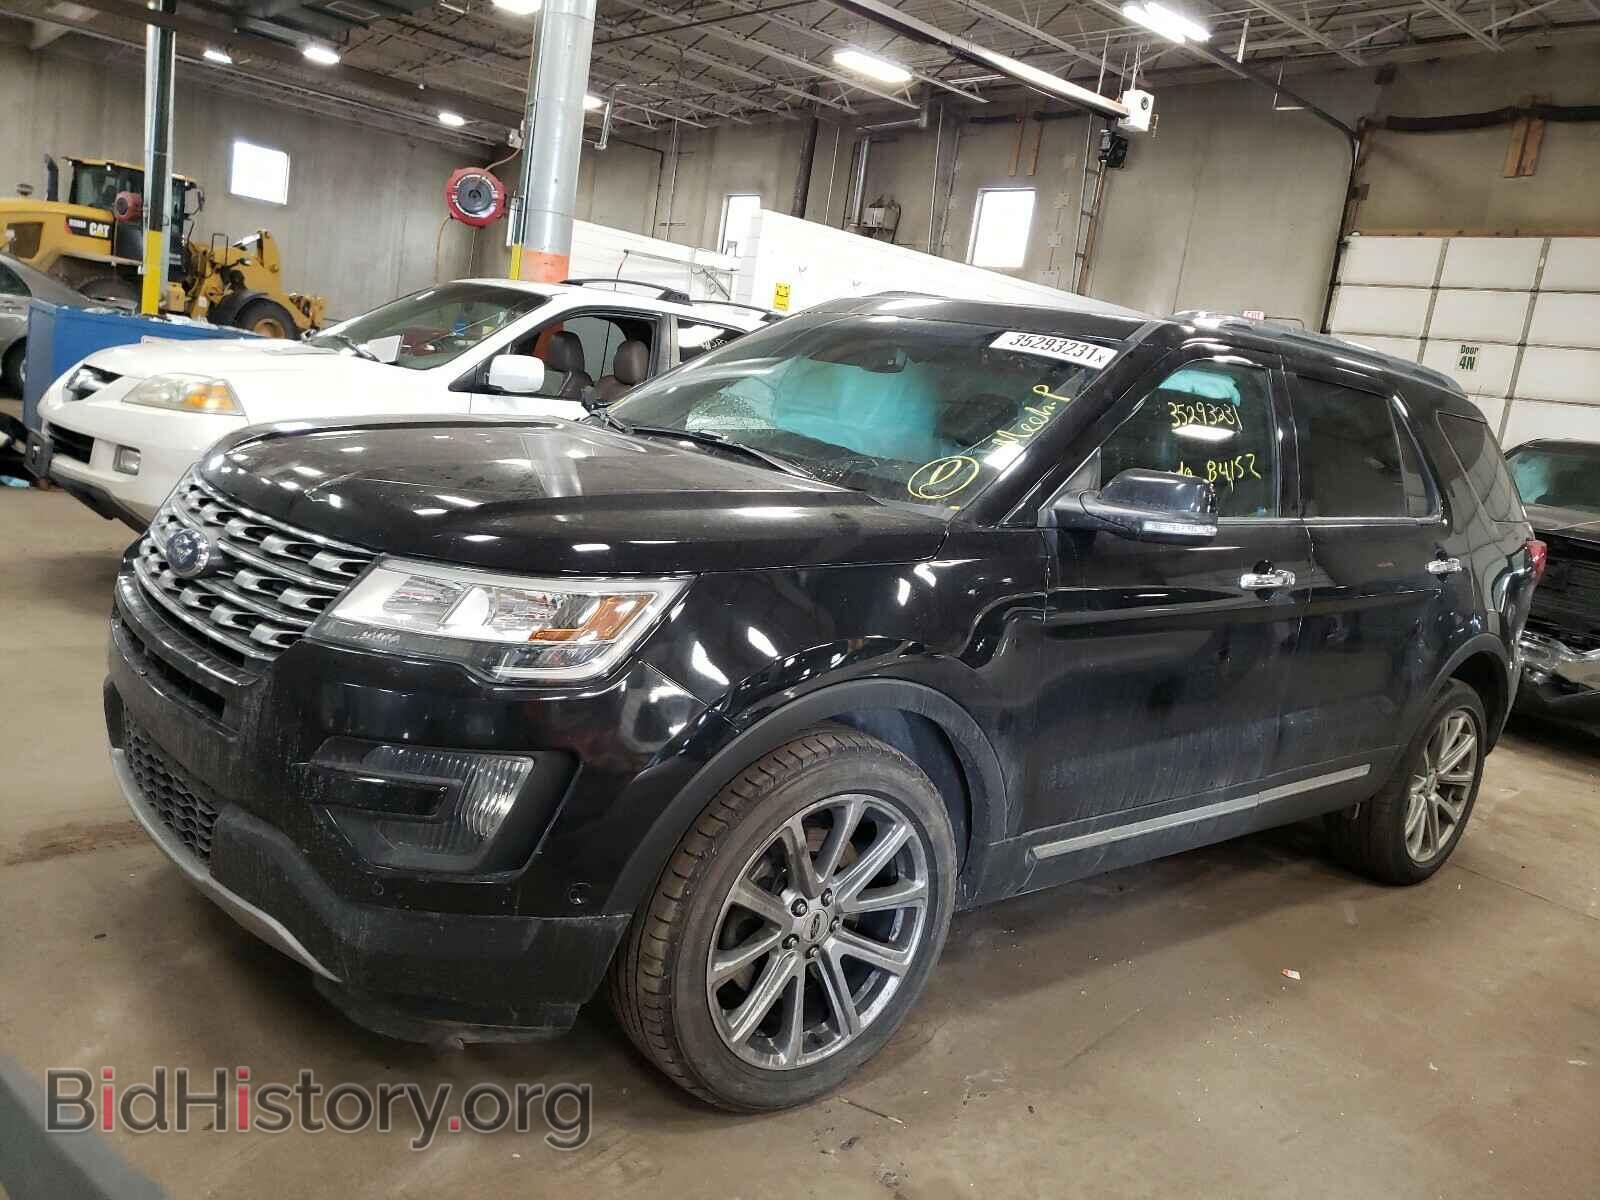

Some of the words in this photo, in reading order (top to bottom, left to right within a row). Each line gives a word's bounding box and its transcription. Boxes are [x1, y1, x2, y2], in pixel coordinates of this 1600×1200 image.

[89, 221, 110, 238] CAT
[1009, 334, 1098, 360] 35293231
[1460, 344, 1479, 354] Door
[1459, 355, 1476, 370] 4N
[1167, 401, 1243, 432] 35293231
